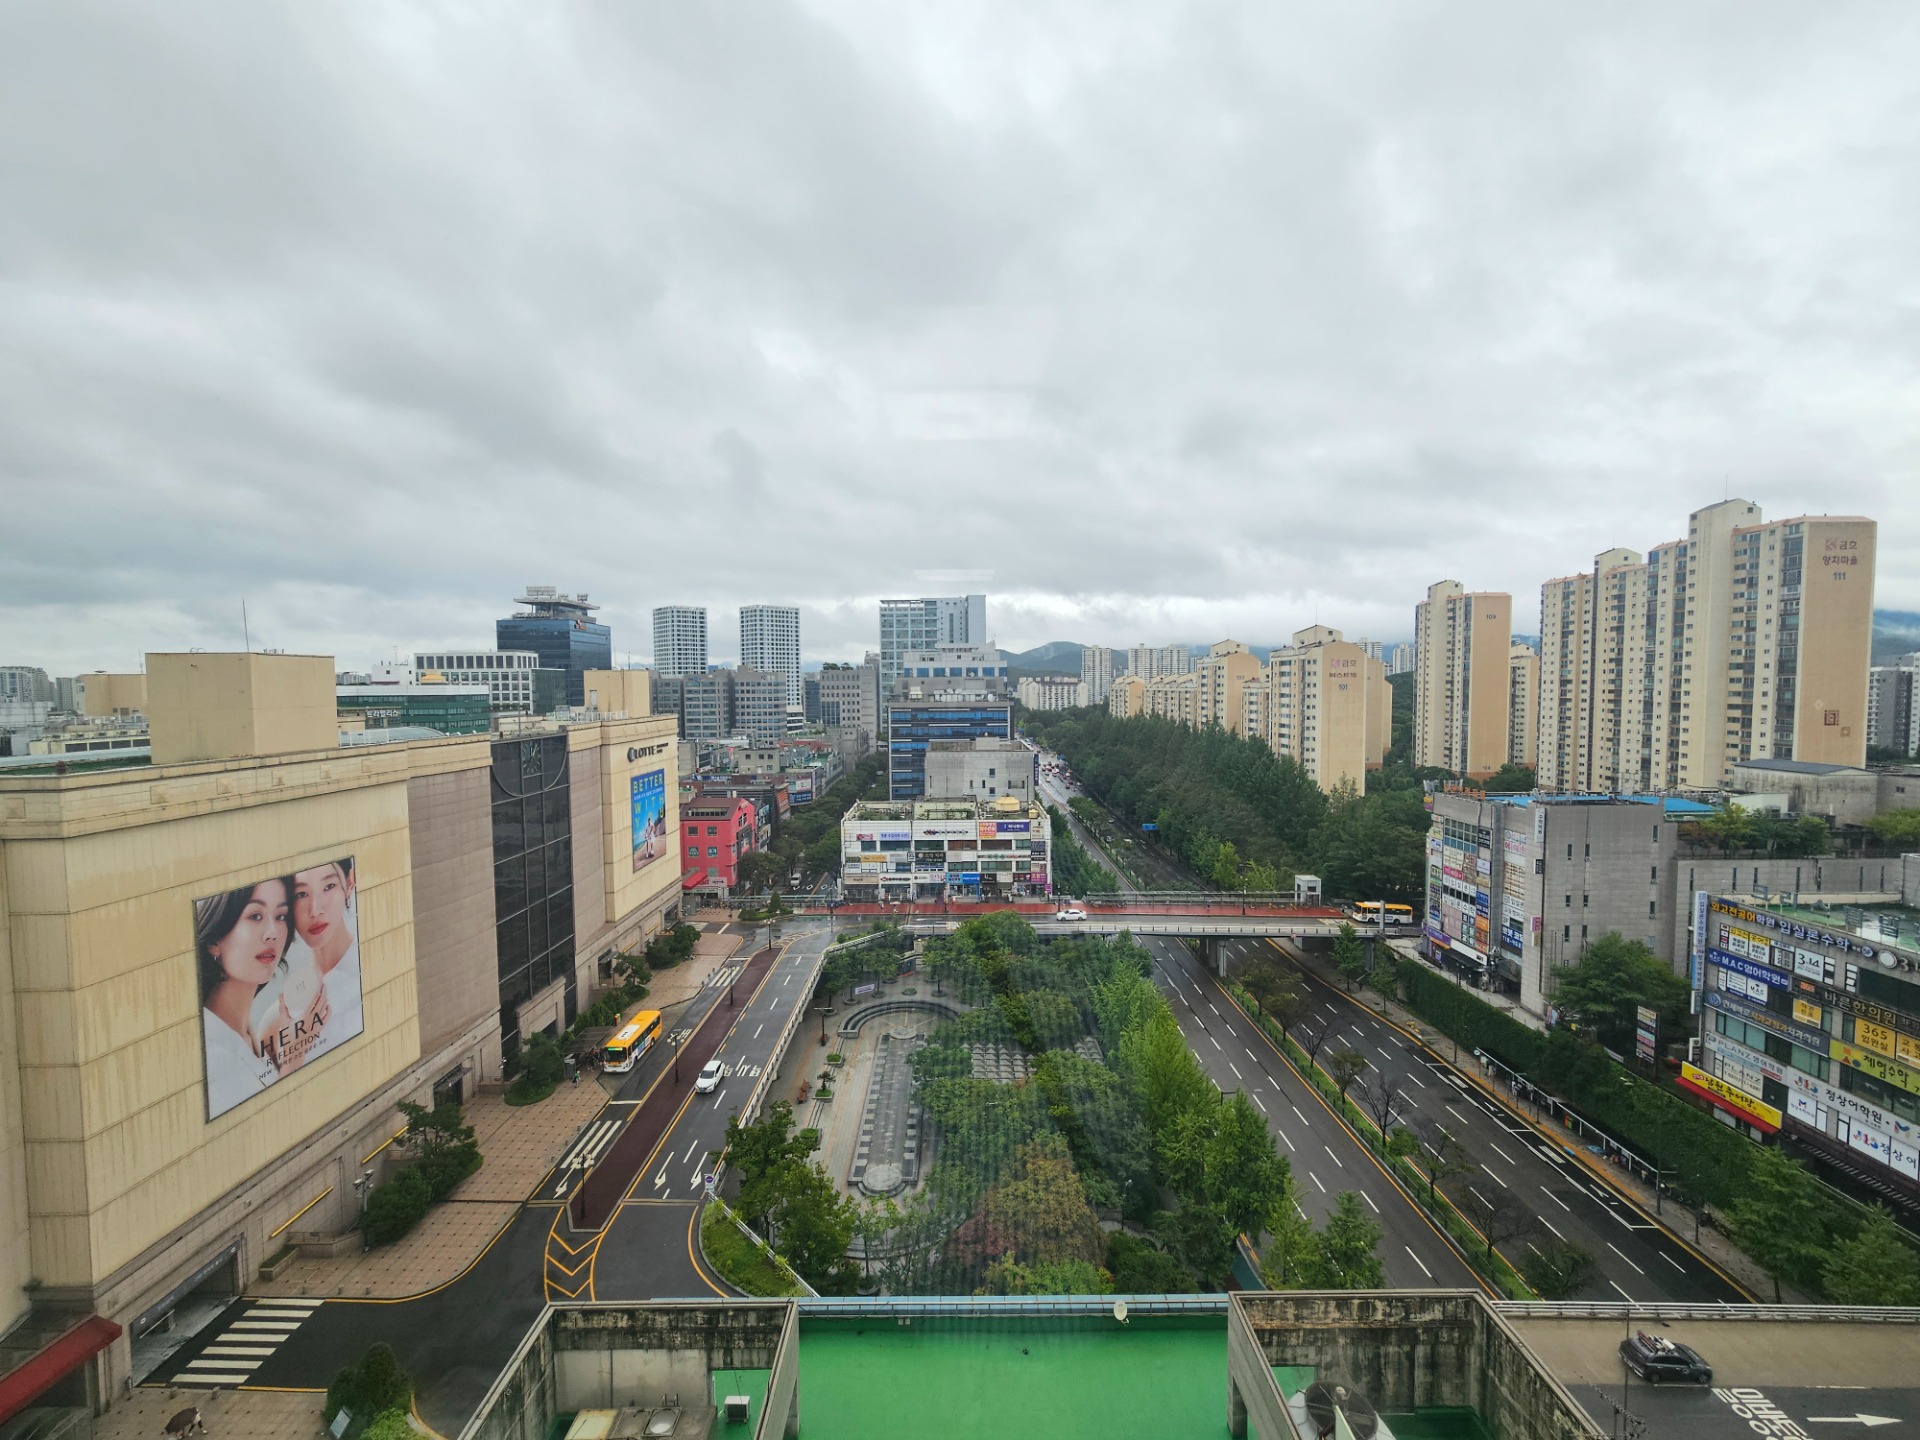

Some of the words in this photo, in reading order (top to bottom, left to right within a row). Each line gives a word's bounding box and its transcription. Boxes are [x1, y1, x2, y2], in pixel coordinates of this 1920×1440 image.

[1839, 539, 1857, 550] 금호
[1822, 554, 1858, 566] 양지마을
[1833, 572, 1847, 581] 111
[1338, 683, 1348, 691] 101
[634, 744, 657, 760] LOTTE
[633, 773, 663, 793] BETTER
[634, 794, 664, 814] WITH
[1711, 901, 1775, 928] 외고전공어학원
[1780, 920, 1850, 953] 입실론수학
[1721, 957, 1781, 985] M.A.C영어학원
[1824, 991, 1896, 1028] 바른한의원
[261, 1012, 324, 1058] HERA
[1863, 1024, 1888, 1040] 365
[1718, 1039, 1751, 1060] PLANZ
[1861, 1034, 1889, 1051] 입원실
[259, 1068, 273, 1080] NEW
[1725, 1062, 1761, 1082] PLANZ
[1863, 1055, 1910, 1088] 체험수학
[1826, 1088, 1882, 1124] 정상어학원
[1711, 1388, 1815, 1440] 일방통
